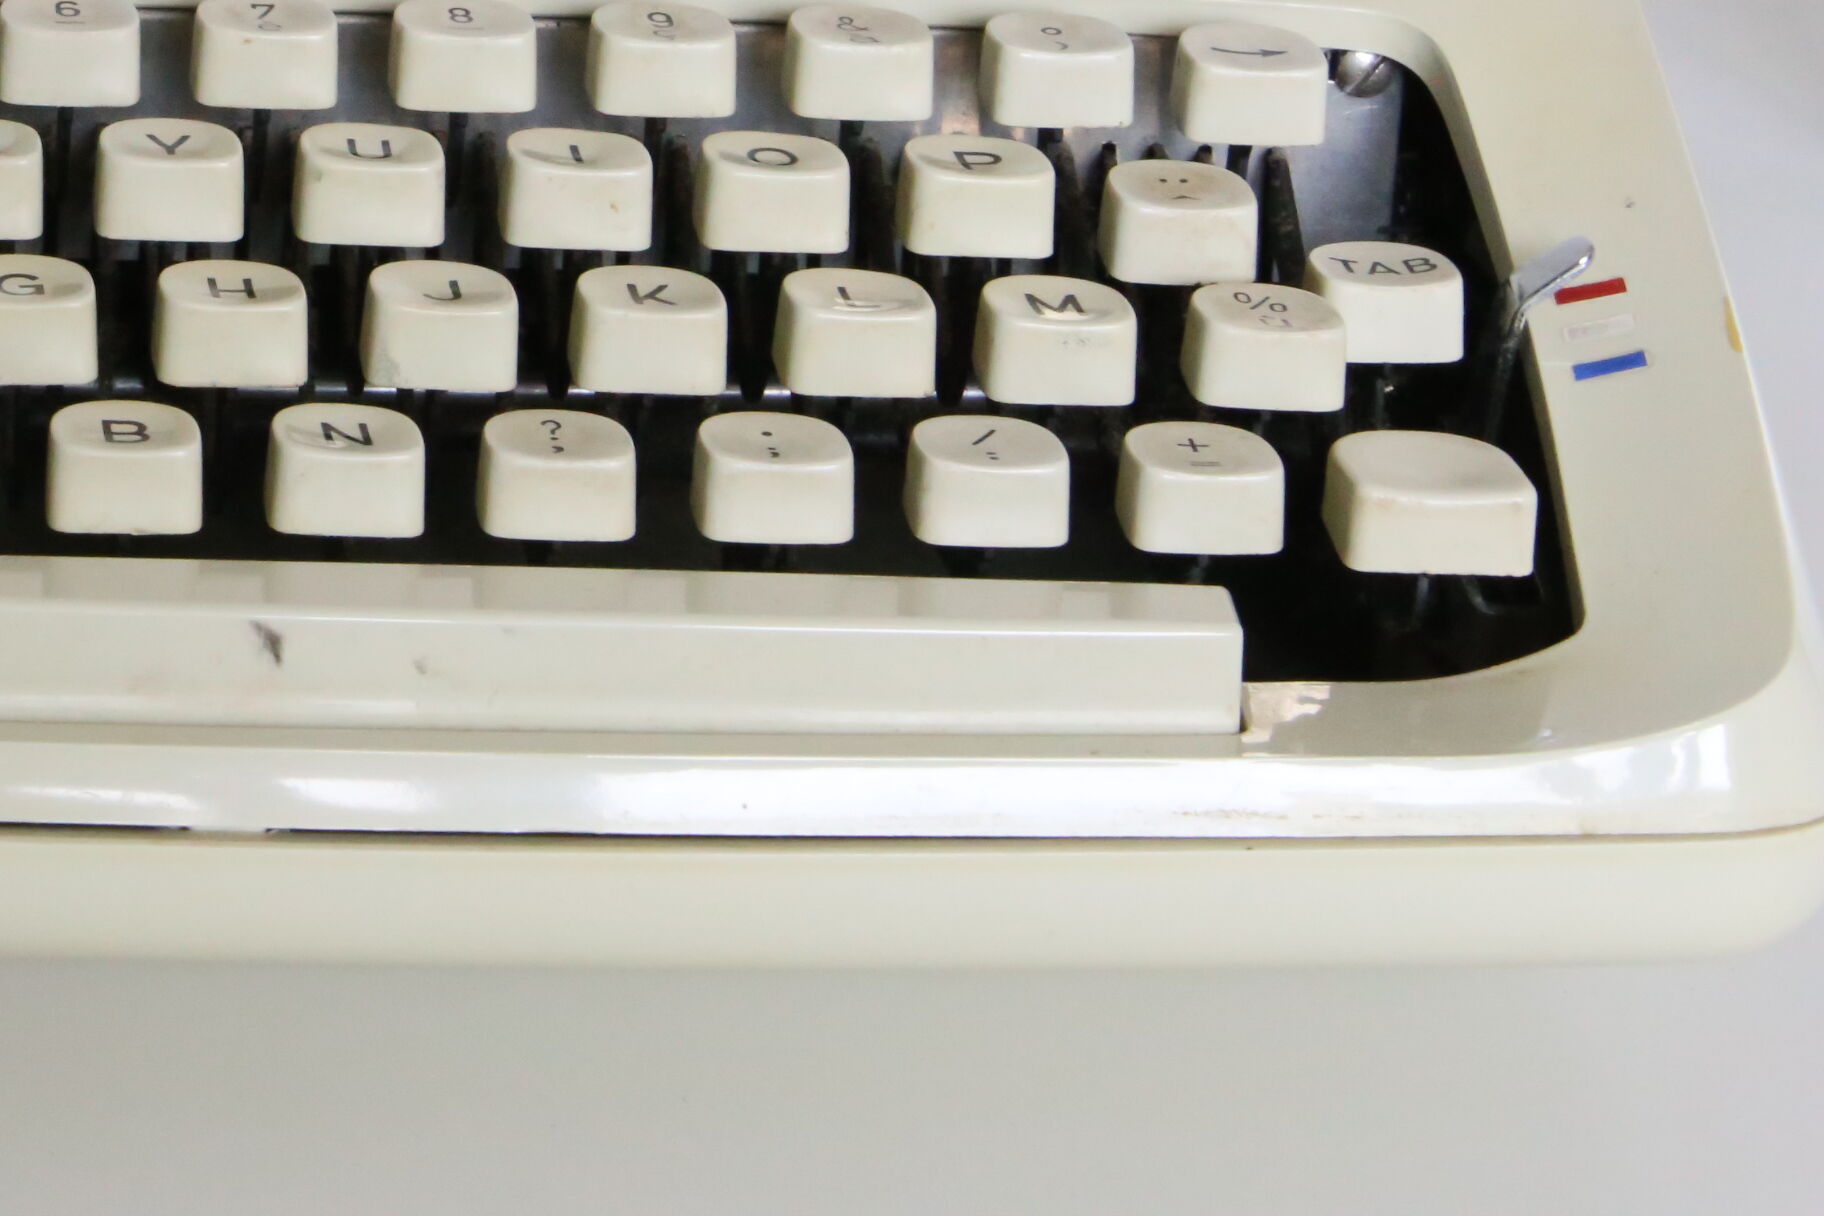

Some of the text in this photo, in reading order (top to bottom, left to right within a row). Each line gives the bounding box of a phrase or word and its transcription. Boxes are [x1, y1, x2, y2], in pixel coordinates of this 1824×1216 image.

[55, 0, 80, 17] 6
[250, 3, 276, 20] 7
[447, 7, 474, 25] 8
[647, 11, 675, 31] 9
[837, 16, 869, 34] &
[146, 133, 192, 155] Y
[346, 138, 391, 159] U
[569, 144, 585, 164] I
[746, 147, 799, 167] O
[953, 150, 1002, 171] P
[1329, 256, 1438, 275] TAB
[206, 277, 257, 299] H
[422, 280, 461, 300] J
[626, 283, 677, 306] K
[837, 286, 881, 308] L
[1024, 293, 1086, 314] M
[1233, 291, 1288, 314] %
[101, 418, 151, 444] B
[321, 420, 373, 447] N
[540, 419, 563, 441] ?
[972, 429, 996, 446] /
[1177, 438, 1210, 453] +
